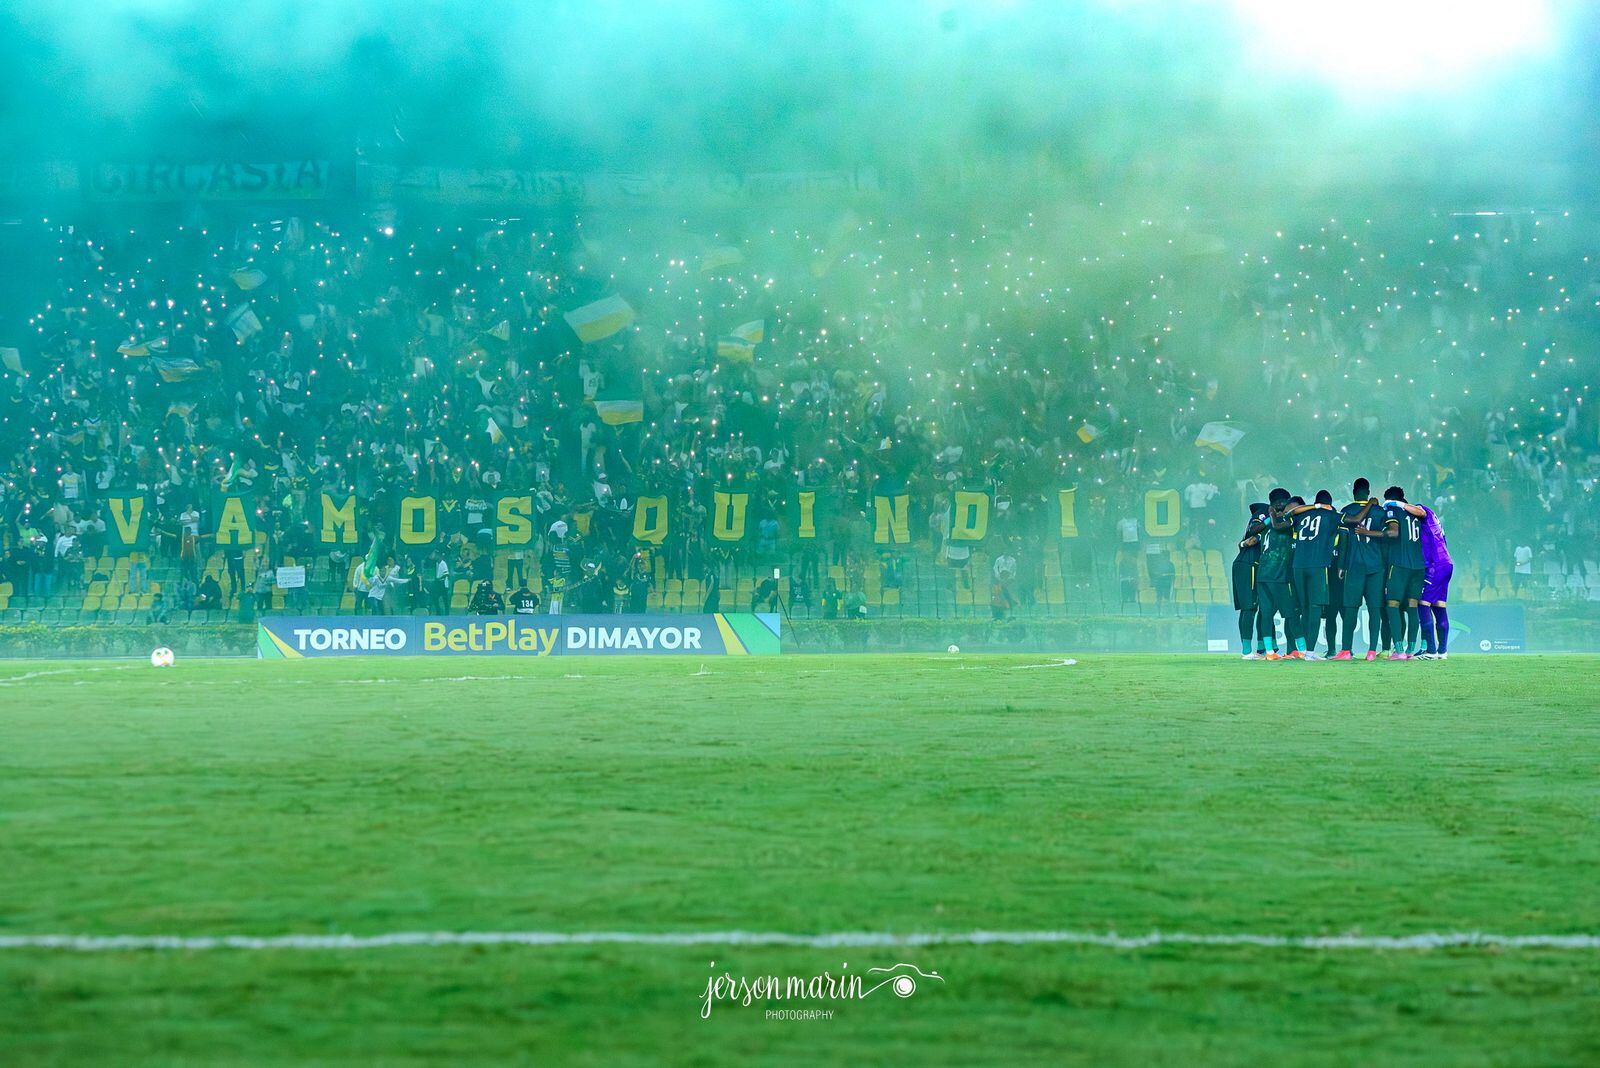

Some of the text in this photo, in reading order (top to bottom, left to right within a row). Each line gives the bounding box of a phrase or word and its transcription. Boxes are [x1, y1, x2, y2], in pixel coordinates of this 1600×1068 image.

[1299, 516, 1321, 541] 29
[1405, 516, 1419, 542] 16
[521, 600, 534, 608] 134
[293, 620, 702, 656] TORNEO BetPlay DIMAYOR
